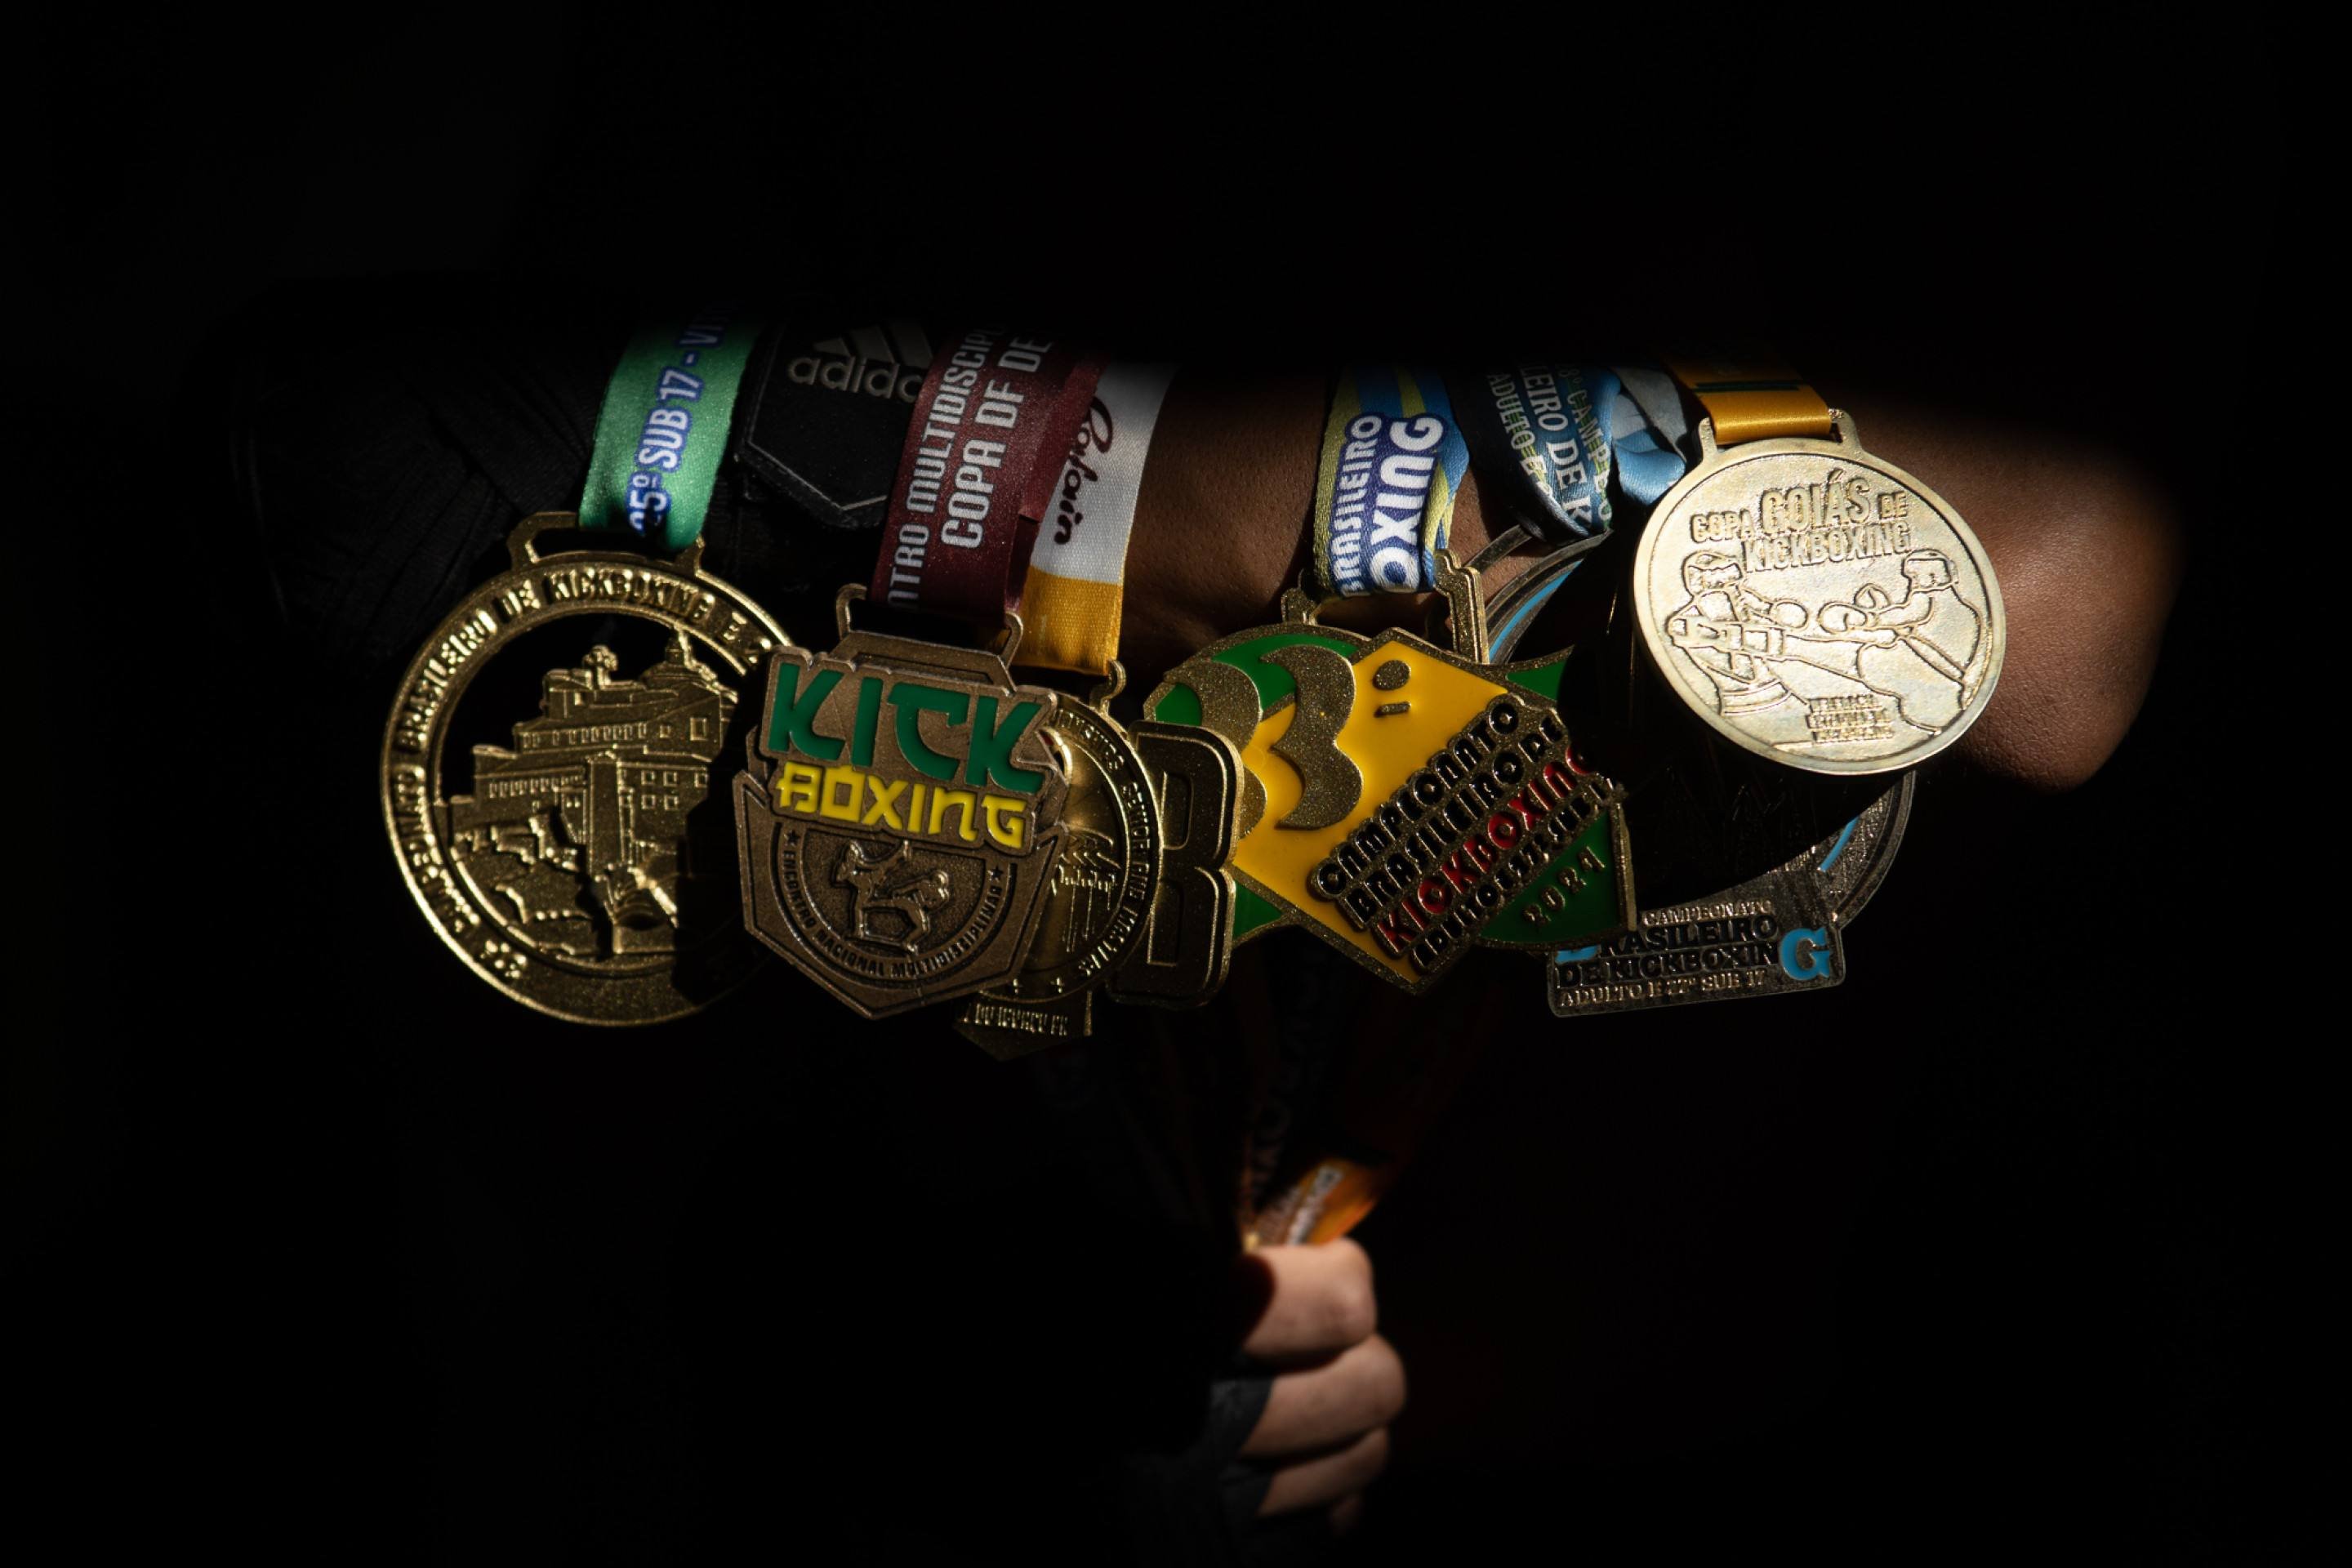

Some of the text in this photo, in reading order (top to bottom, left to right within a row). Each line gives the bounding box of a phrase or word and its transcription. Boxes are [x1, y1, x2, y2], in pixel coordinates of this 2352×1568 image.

[658, 368, 701, 400] 17
[1485, 372, 1536, 450] ADULTO
[637, 408, 689, 470] SUB
[940, 336, 1056, 549] COPA DF DE
[1545, 438, 1588, 490] DE
[1369, 416, 1444, 594] OXING
[1689, 467, 1909, 545] COPA GOIÁS DE
[1742, 520, 1912, 573] KICKBOXING
[546, 567, 717, 626] KICKBOXING
[767, 661, 1045, 795] KICK
[775, 760, 1028, 849] BOXING
[1316, 702, 1519, 896] CAMPEONATO
[1344, 751, 1525, 924] BRASILEIRO
[782, 849, 1004, 980] ENCONTRO NACIONAL MULTIDISCIPLINAR
[1521, 844, 1608, 929] 2021
[1642, 900, 1775, 927] CAMPEONATO
[1559, 981, 1644, 1009] ADULTO
[1700, 972, 1740, 991] SUB
